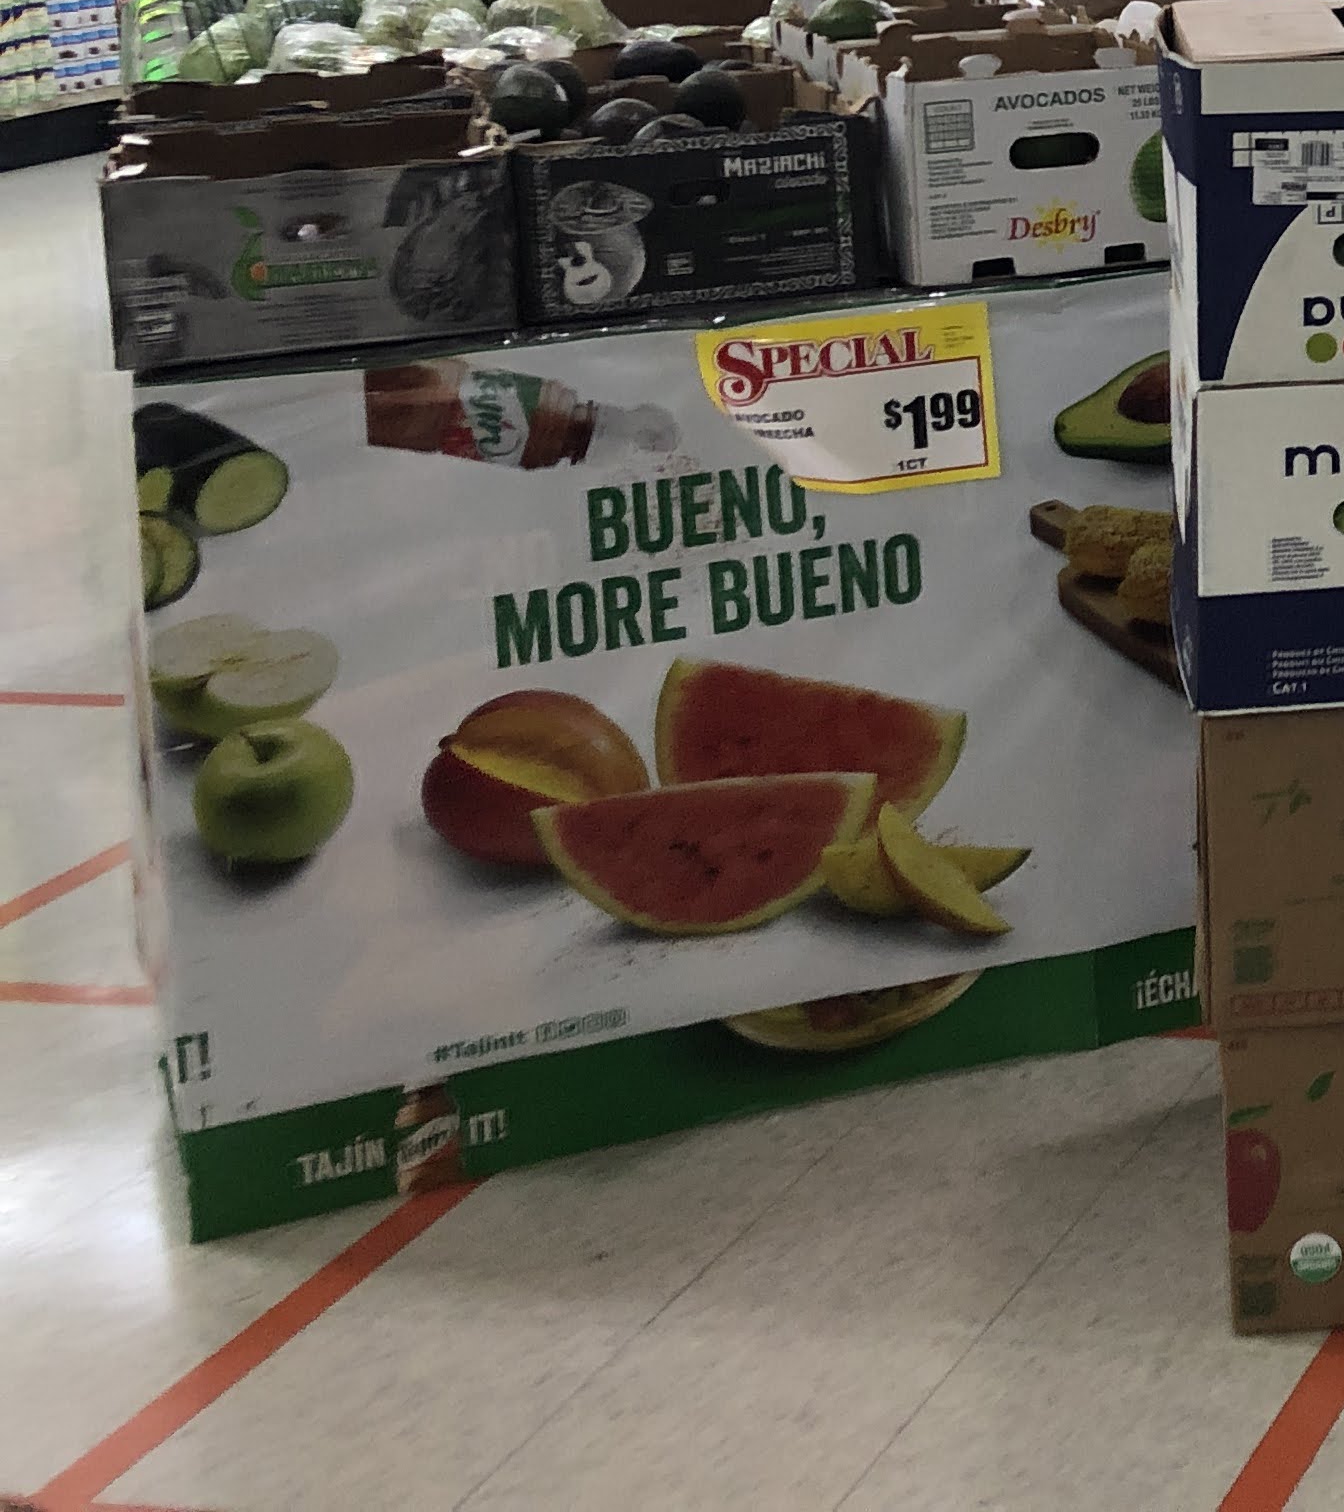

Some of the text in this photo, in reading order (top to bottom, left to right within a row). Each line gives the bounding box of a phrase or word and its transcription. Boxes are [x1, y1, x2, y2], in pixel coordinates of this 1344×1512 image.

[994, 88, 1105, 112] AVOCADOS
[1008, 208, 1097, 243] Desbry
[1325, 205, 1336, 218] P
[714, 328, 934, 406] SPECIAL
[587, 464, 827, 562] BUENO,
[493, 533, 923, 669] MORE BUENO
[296, 1134, 387, 1185] TAJÍN
[469, 1108, 508, 1146] IT!
